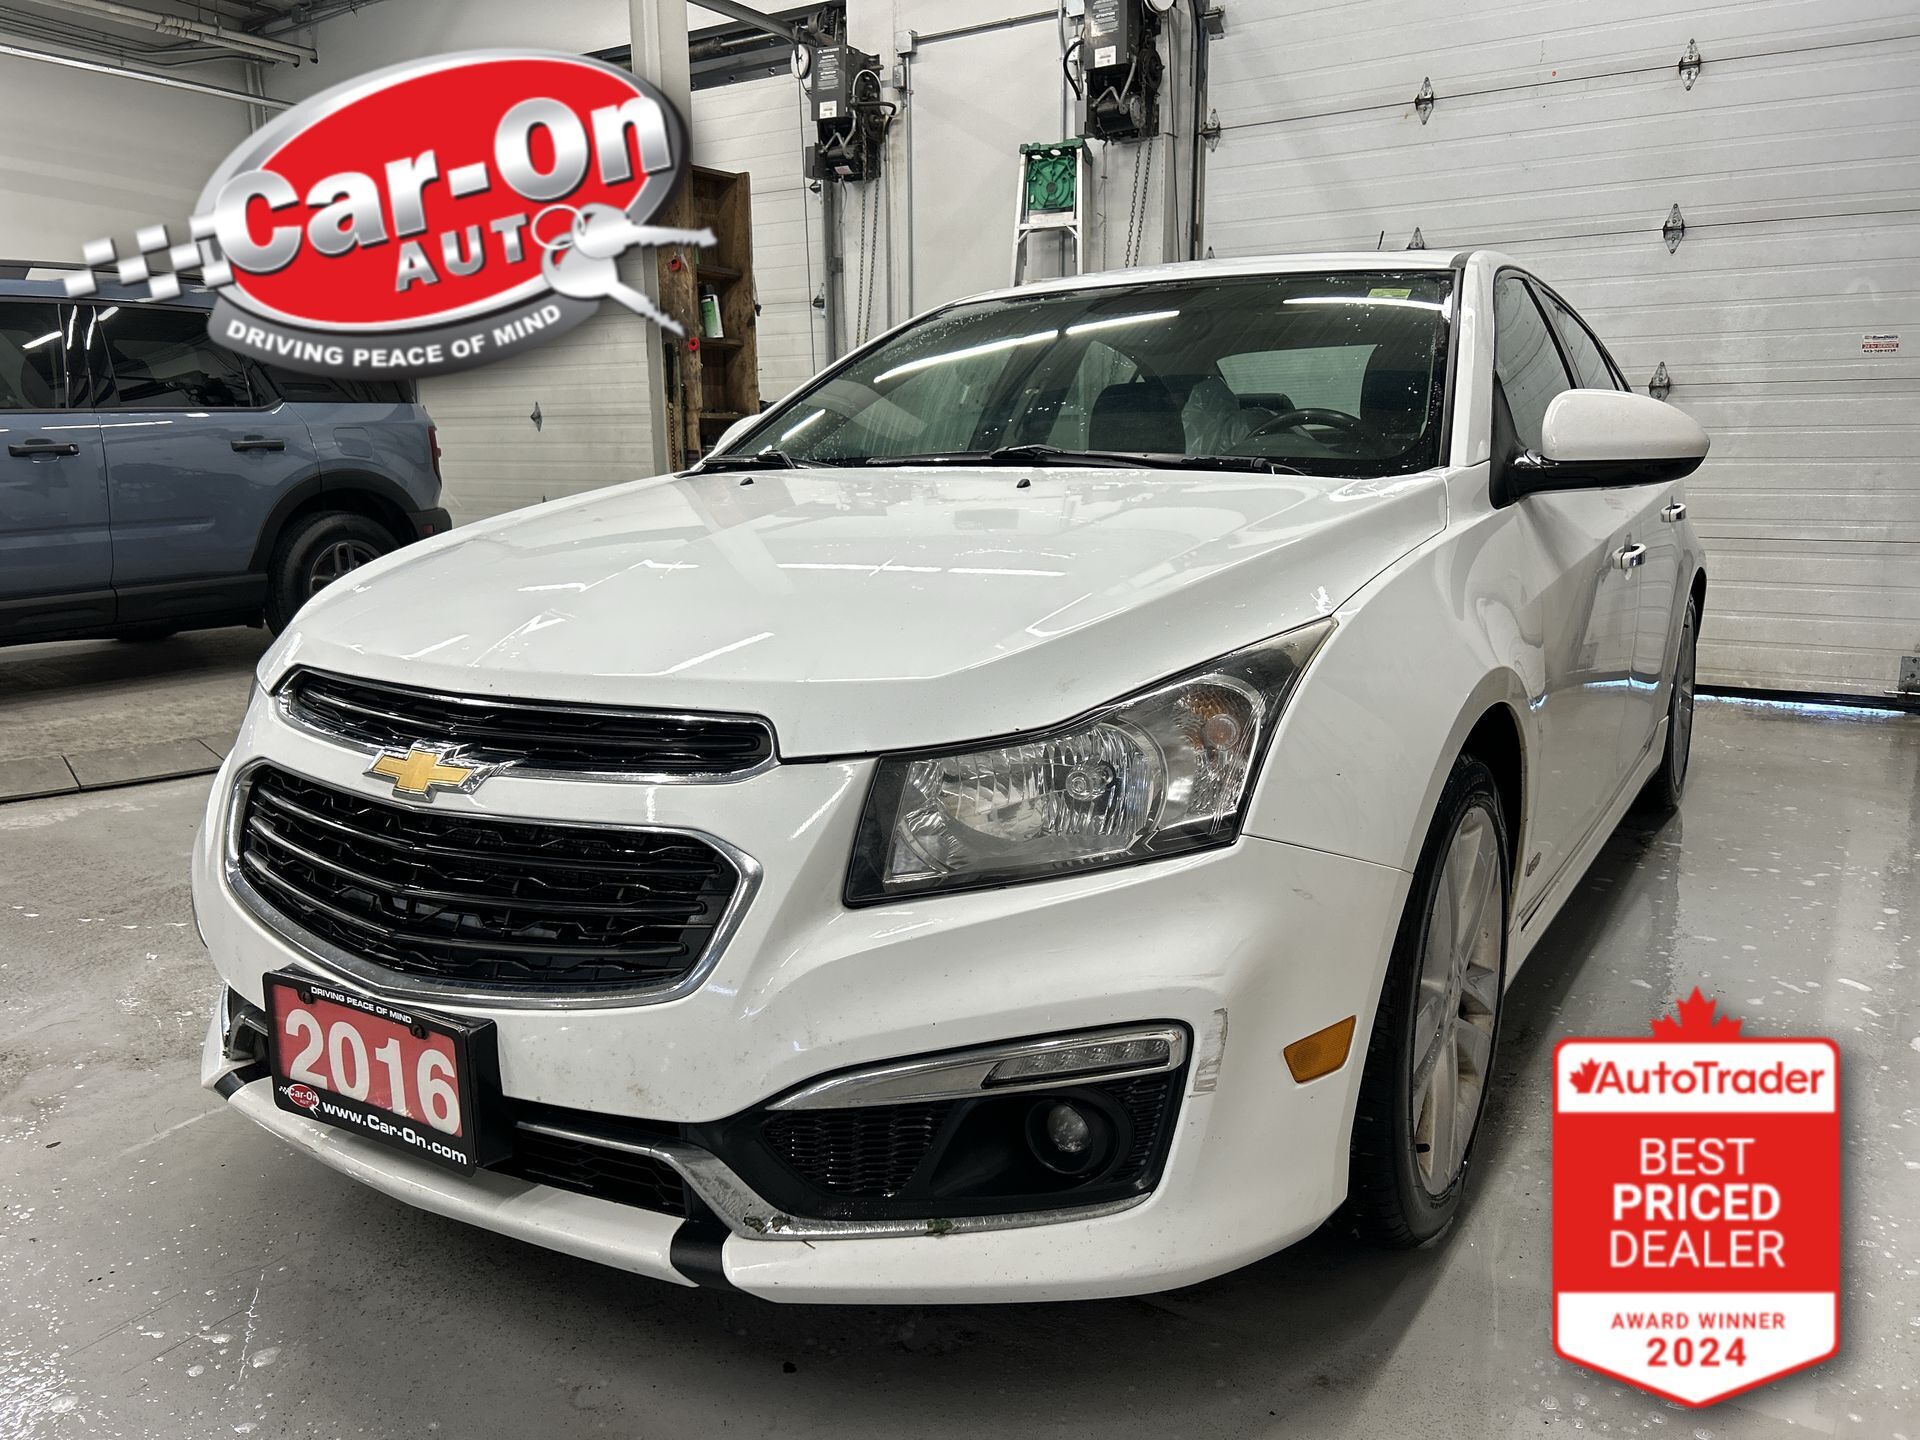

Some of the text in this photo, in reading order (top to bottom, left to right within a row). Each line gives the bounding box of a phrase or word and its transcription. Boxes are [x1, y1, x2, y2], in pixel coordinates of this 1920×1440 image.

[310, 986, 412, 1024] DRIVING PEACE OF MIND
[285, 1008, 461, 1135] 2016
[288, 1087, 319, 1102] Car-On
[321, 1101, 467, 1165] www.Car-On.com
